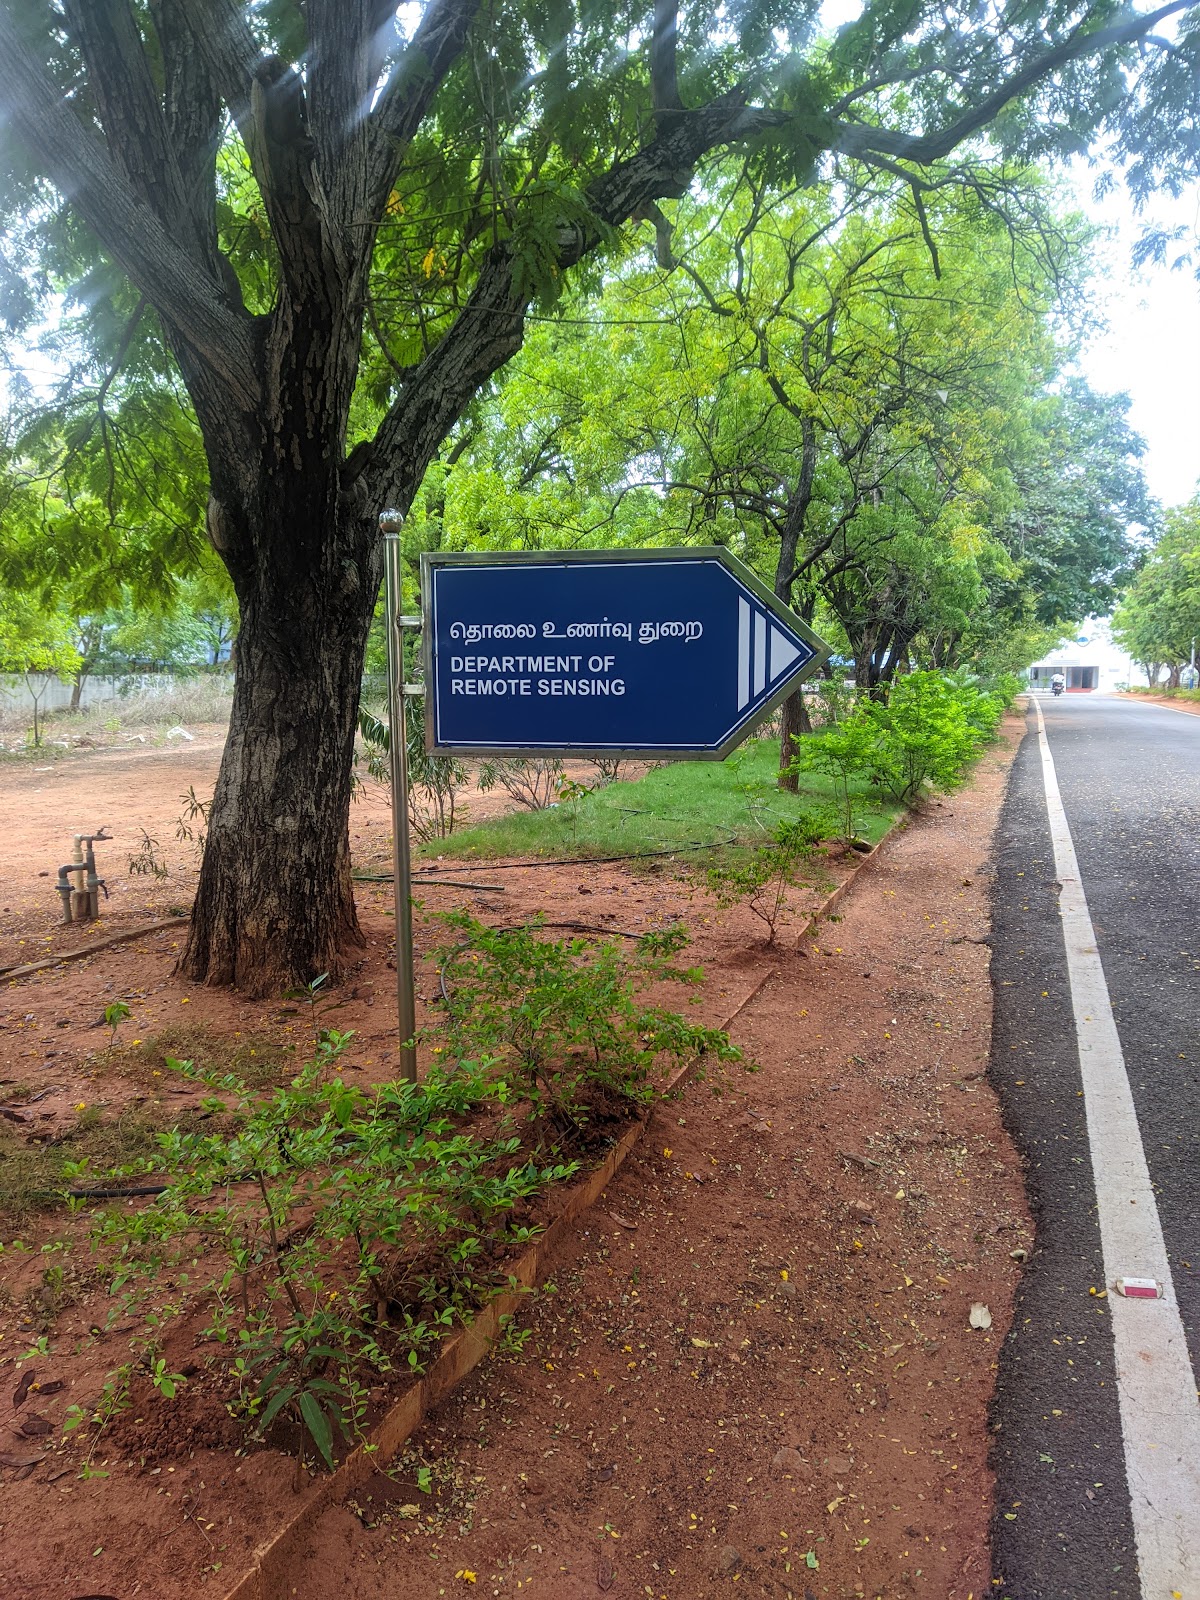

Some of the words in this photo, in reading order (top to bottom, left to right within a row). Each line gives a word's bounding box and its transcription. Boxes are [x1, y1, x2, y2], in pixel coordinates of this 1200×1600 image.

[449, 621, 536, 645] தொலை
[542, 617, 632, 641] உணர்வு
[638, 620, 703, 644] துறை
[451, 656, 582, 673] DEPARTMENT
[588, 655, 615, 672] OF
[451, 679, 532, 695] REMOTE
[537, 679, 626, 696] SENSING
